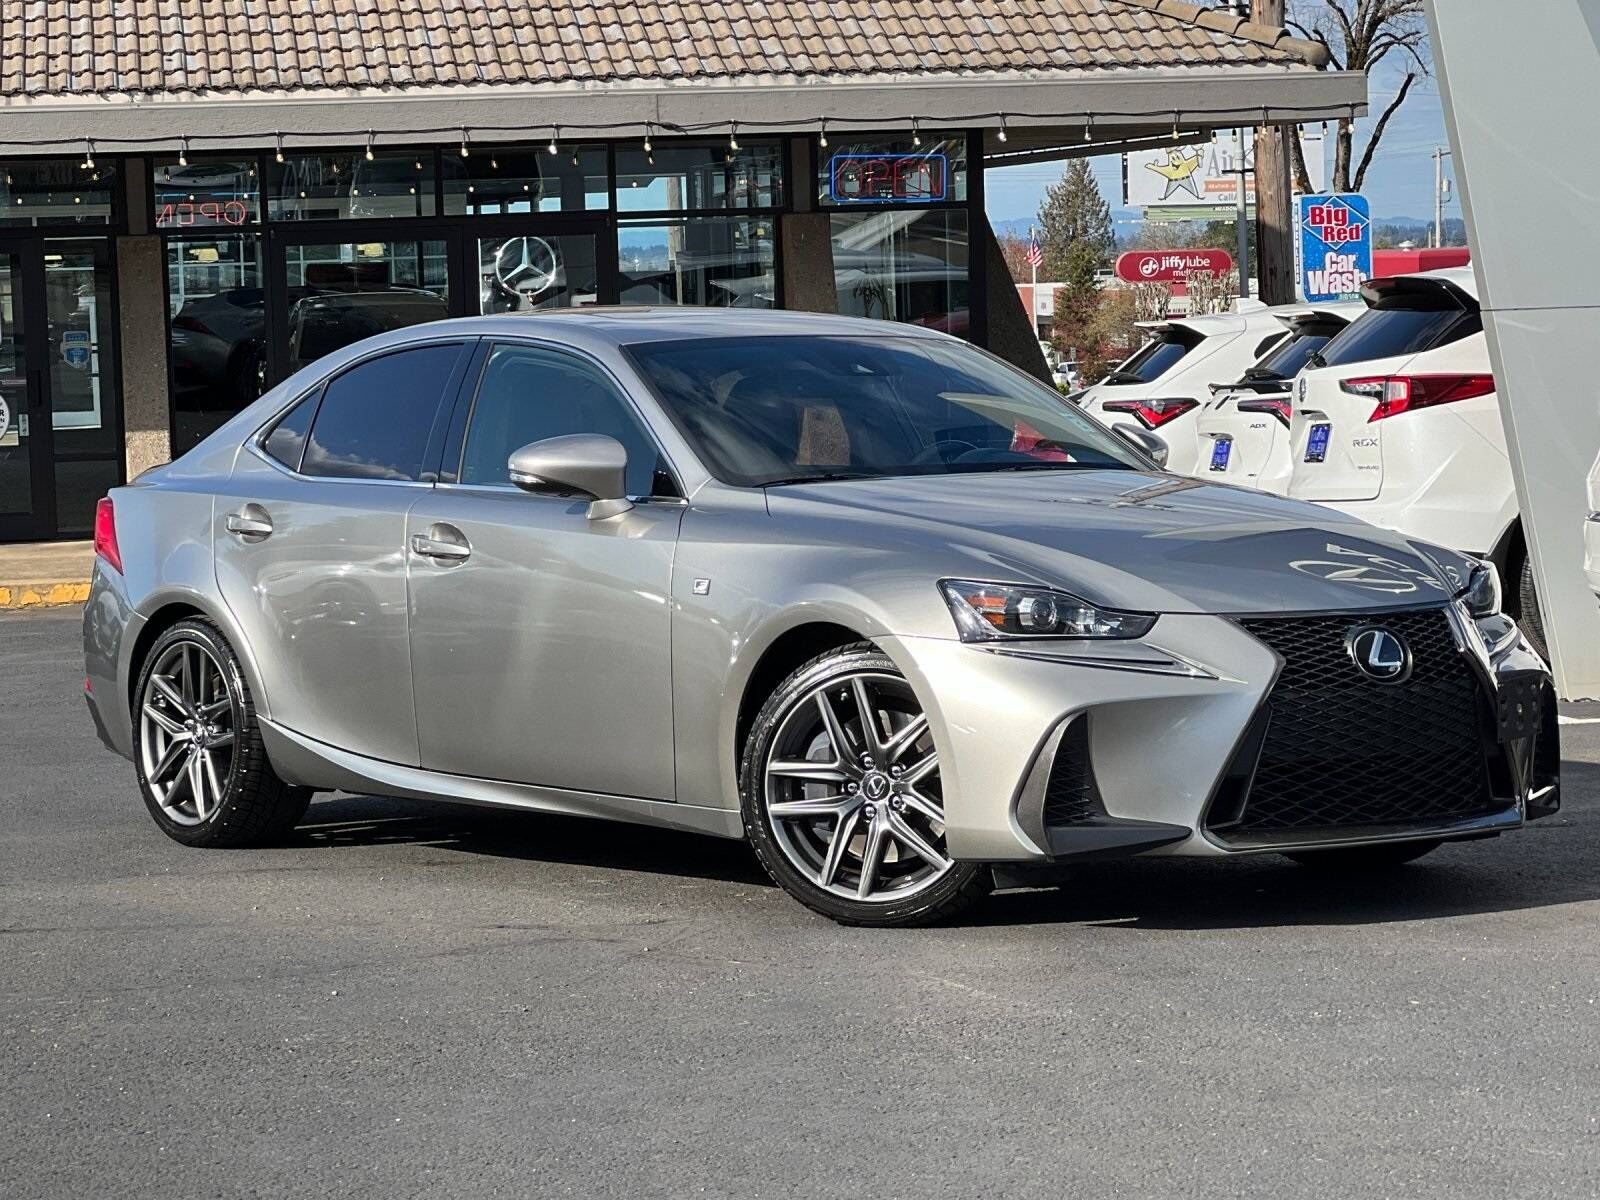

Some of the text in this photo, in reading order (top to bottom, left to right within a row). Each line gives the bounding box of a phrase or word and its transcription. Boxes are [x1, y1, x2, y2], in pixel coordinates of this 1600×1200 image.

[837, 159, 942, 197] OPEN
[1309, 205, 1348, 227] Big
[1323, 223, 1361, 242] Red
[1161, 256, 1210, 271] jiffy lube
[1325, 252, 1356, 273] Car
[1307, 268, 1367, 295] Wash
